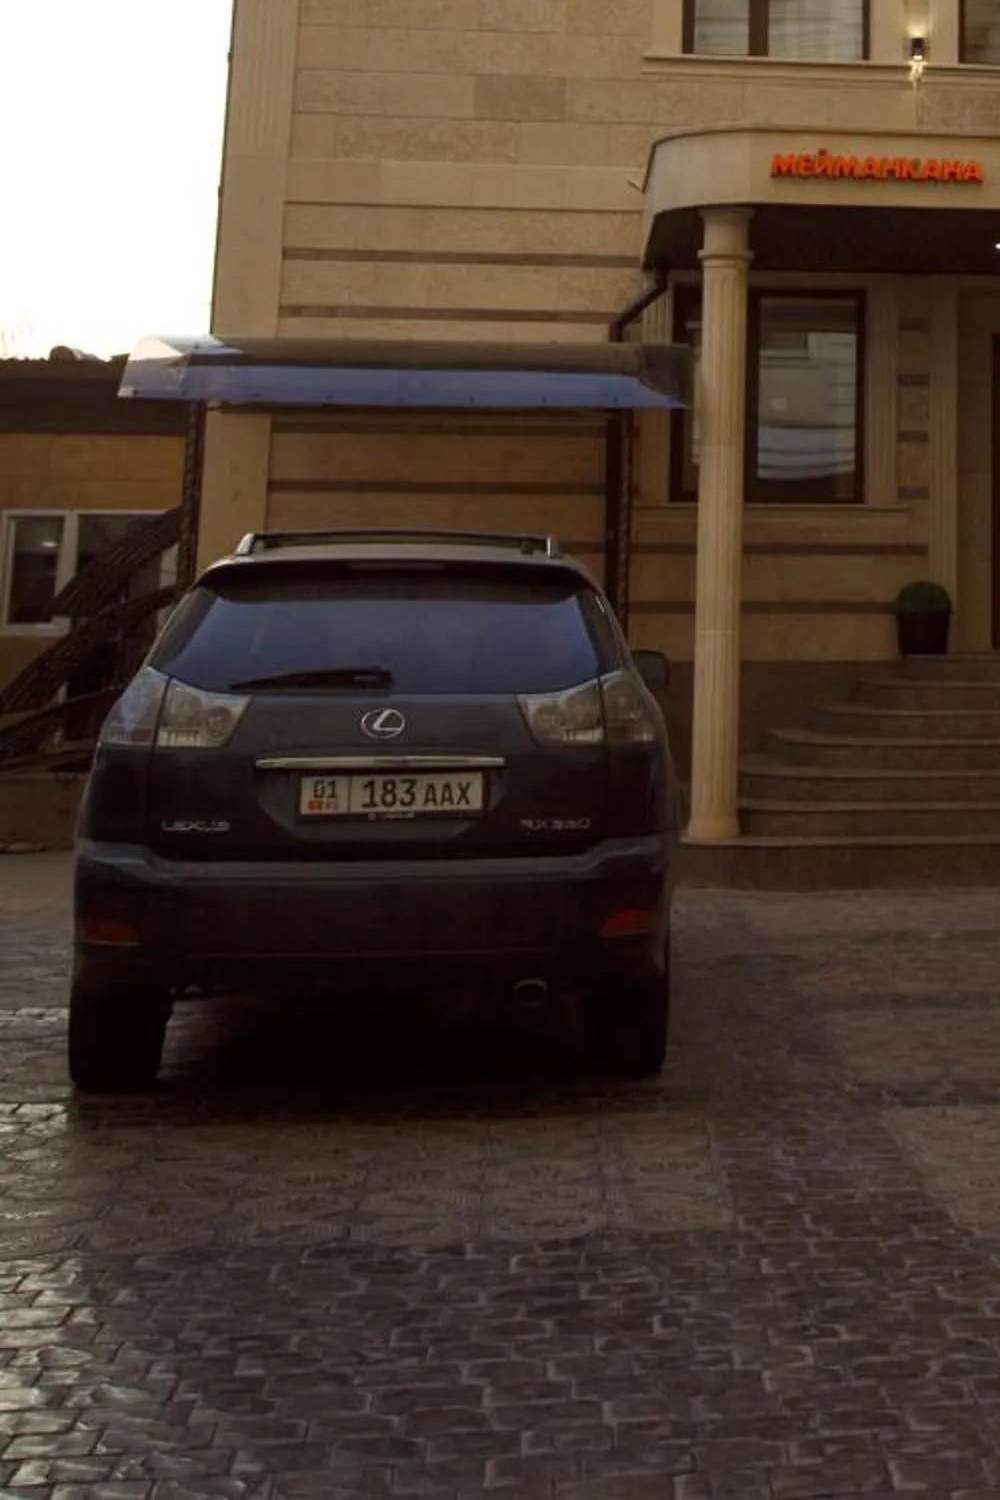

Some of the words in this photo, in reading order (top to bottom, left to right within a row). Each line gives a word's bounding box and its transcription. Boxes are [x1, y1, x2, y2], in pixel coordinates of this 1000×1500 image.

[771, 149, 982, 184] МЕЙМАНКАНА
[313, 780, 337, 799] 01
[361, 779, 417, 808] 183
[423, 781, 471, 807] AAX
